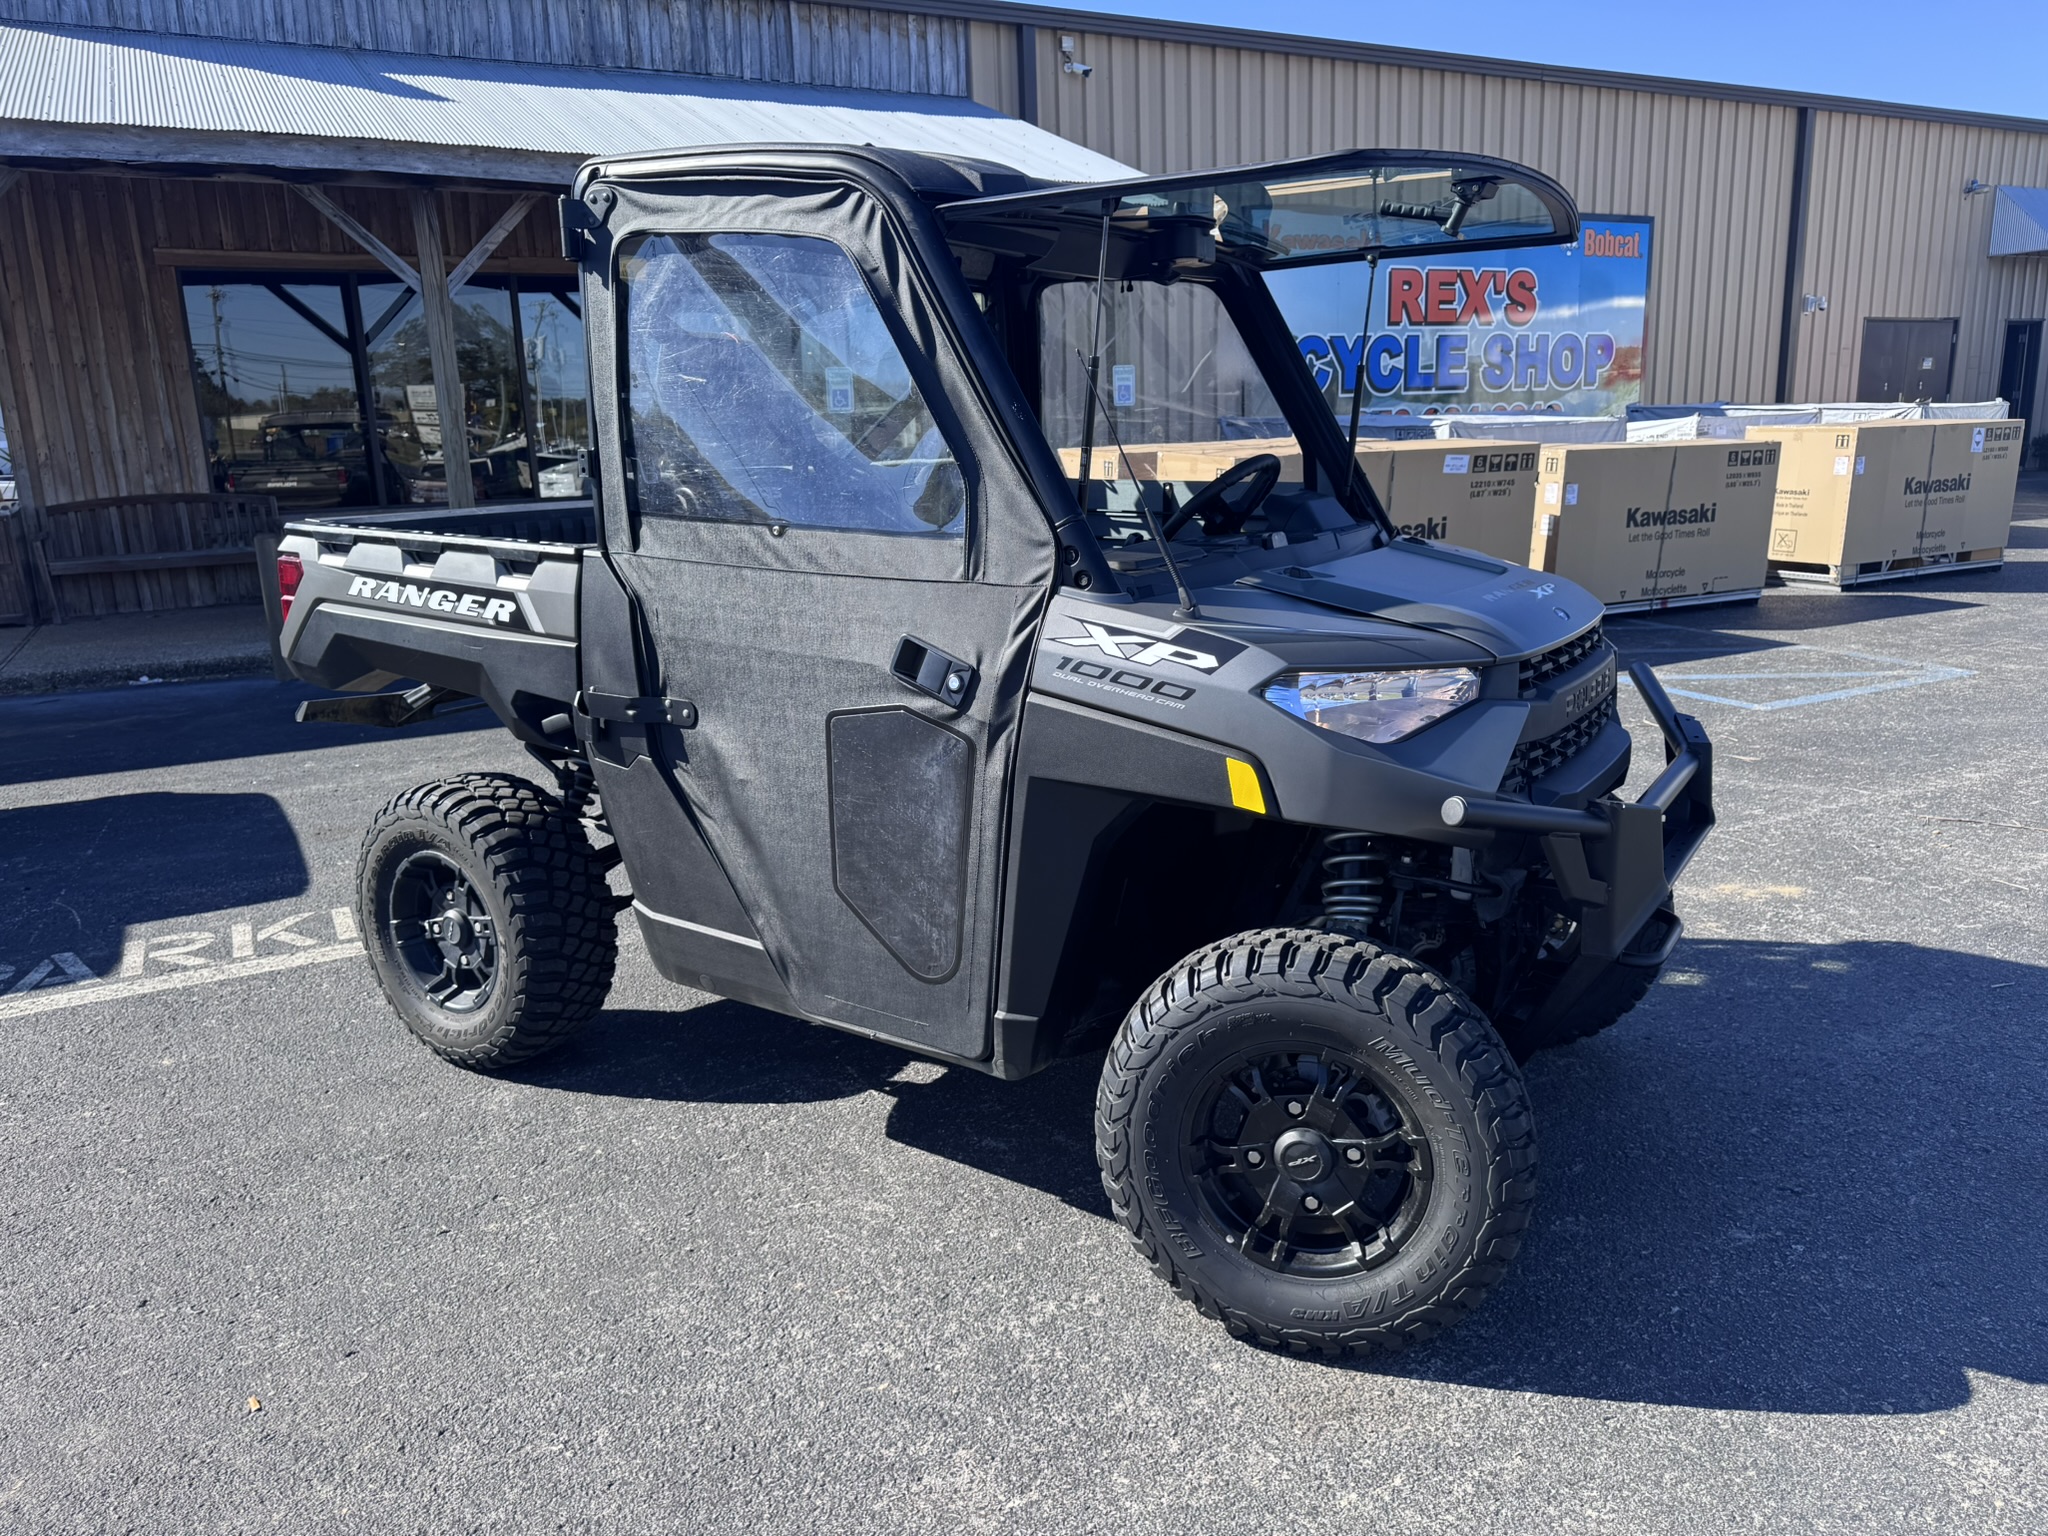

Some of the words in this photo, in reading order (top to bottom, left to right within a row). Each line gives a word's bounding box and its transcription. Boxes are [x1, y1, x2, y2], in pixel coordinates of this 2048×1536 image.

[1583, 228, 1641, 258] Bobcat
[1387, 266, 1538, 328] REX'S
[1297, 332, 1470, 397] CYCLE
[1480, 331, 1616, 392] SHOP
[1904, 472, 1971, 495] Kawasaki
[1938, 496, 1954, 505] Times
[1393, 516, 1447, 540] saki
[1626, 502, 1717, 528] Kawasaki
[1628, 531, 1641, 543] Let
[1641, 530, 1653, 541] the
[1674, 529, 1695, 540] Times
[1697, 527, 1711, 537] Roll
[1912, 543, 1947, 555] Moocyclette
[1645, 567, 1686, 579] Moorcycle
[348, 576, 517, 623] RANGER
[1528, 582, 1556, 600] XP
[1047, 621, 1219, 668] XP
[1052, 671, 1084, 684] DUAL
[1087, 681, 1154, 702] OVERHEAD
[1155, 698, 1186, 710] CAM
[1056, 656, 1197, 701] 1000
[1566, 667, 1611, 718] POLARIS
